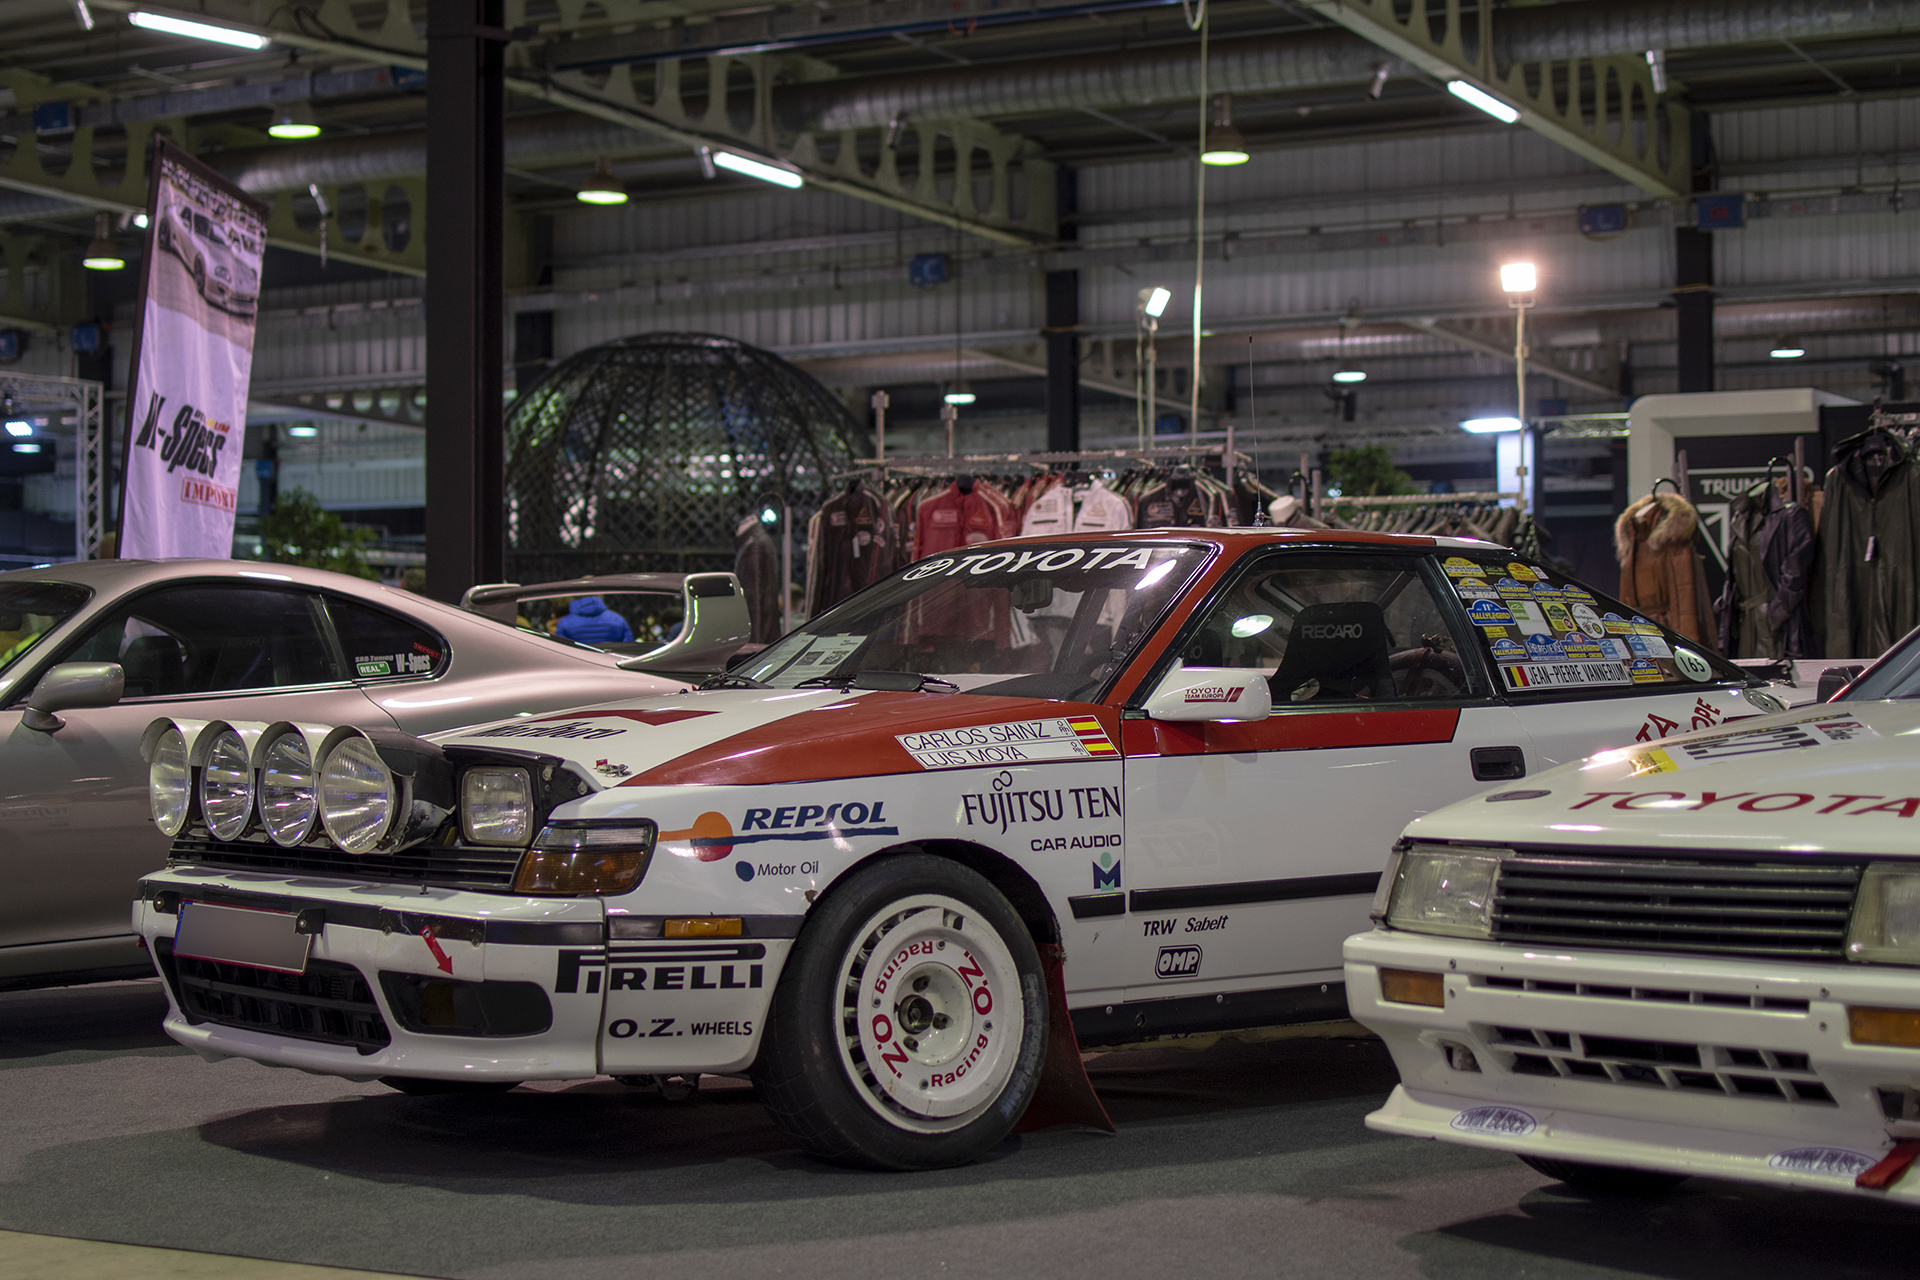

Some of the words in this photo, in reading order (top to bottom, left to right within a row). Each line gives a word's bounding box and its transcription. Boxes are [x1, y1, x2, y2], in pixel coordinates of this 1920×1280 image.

[184, 481, 235, 508] IMPORT
[1700, 477, 1768, 500] TRIUM
[946, 548, 1153, 575] TOYOTA
[1302, 623, 1362, 639] RECARO
[360, 665, 380, 673] REAL
[395, 653, 430, 673] W-Specs
[1680, 657, 1705, 673] 165
[1528, 665, 1584, 685] JEAN-PIERRE
[1186, 687, 1223, 695] TOYOTA
[1685, 697, 1720, 733] OPE
[904, 728, 988, 750] CARLOS
[994, 722, 1050, 742] SAINZ
[916, 751, 967, 767] LUIS
[969, 746, 1027, 763] MOYA
[741, 801, 886, 831] REPSOL
[962, 788, 1064, 835] FUJITSU
[1069, 786, 1122, 818] TEN
[1568, 792, 1920, 818] TOYOTA
[1031, 837, 1067, 851] CAR
[1069, 834, 1121, 849] AUDIO
[757, 863, 796, 876] Motor
[800, 860, 819, 875] Oil
[1143, 919, 1177, 936] TRW
[1185, 915, 1229, 933] Sabelt
[555, 943, 766, 993] PIRELLI
[874, 941, 933, 994] Racing
[1158, 951, 1199, 973] OMP
[691, 1021, 753, 1036] WHEELS
[931, 1033, 988, 1087] Racing
[1457, 1107, 1496, 1128] TWIN
[1486, 1109, 1533, 1134] BUSCH
